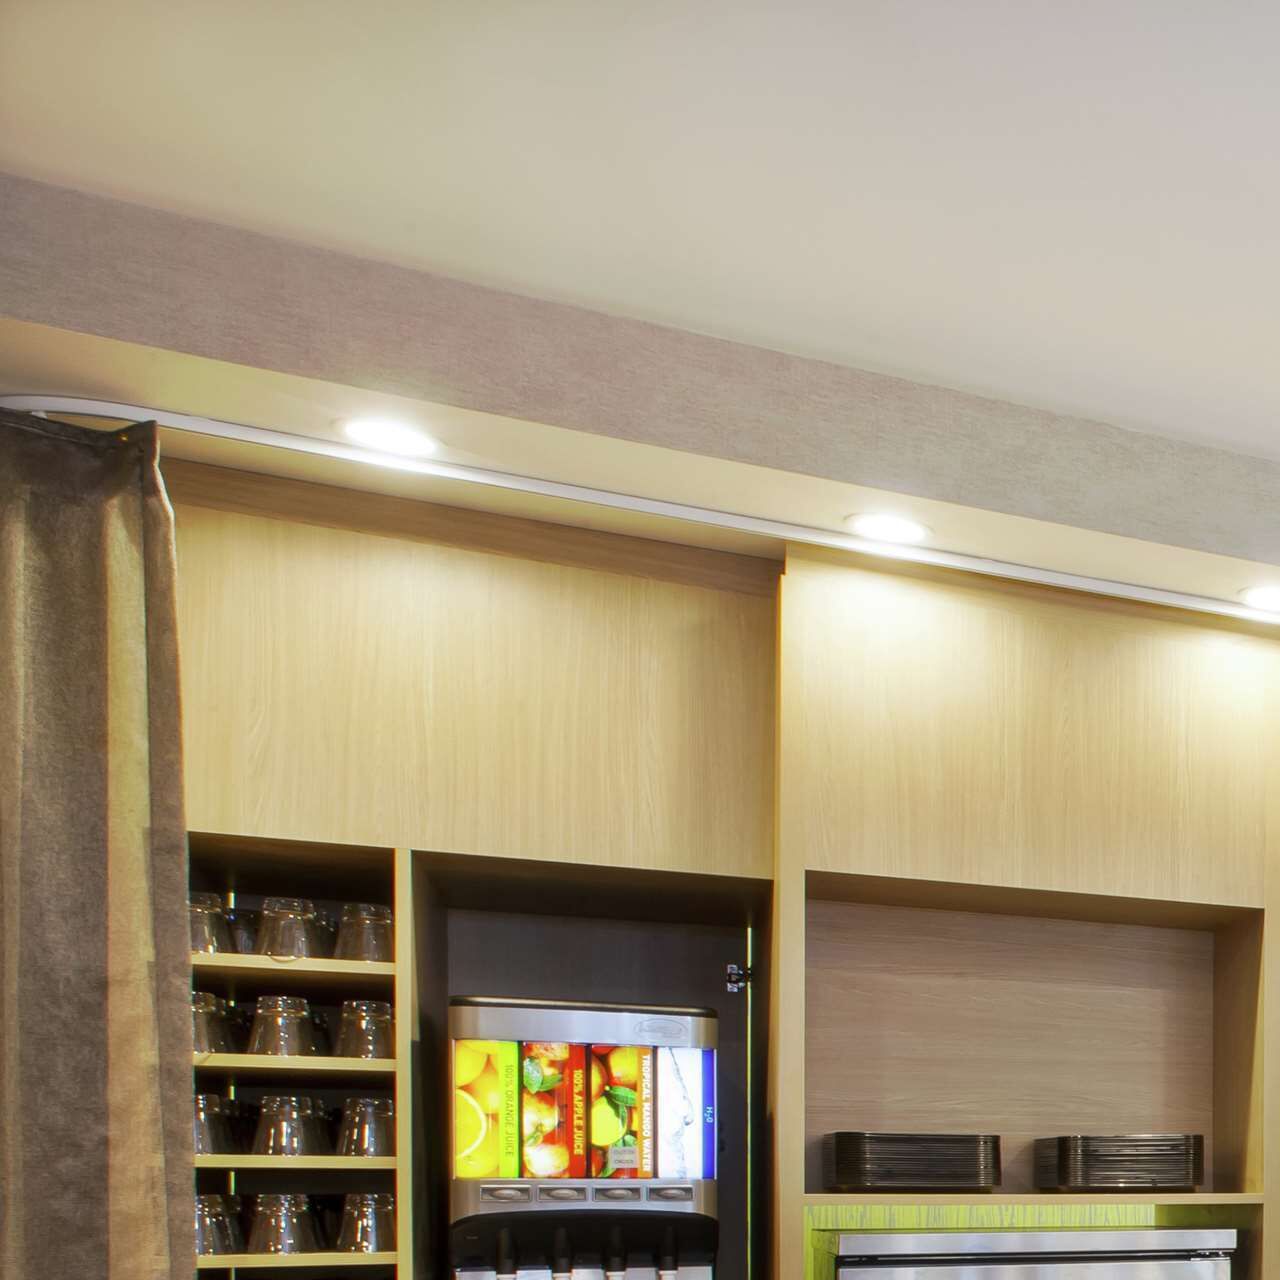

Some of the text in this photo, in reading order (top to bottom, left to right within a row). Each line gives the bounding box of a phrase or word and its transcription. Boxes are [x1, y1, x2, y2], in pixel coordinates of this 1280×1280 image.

[504, 1064, 515, 1157] 100% ORANGE JUICE
[573, 1069, 584, 1155] 100% APPLE JUICE
[641, 1054, 651, 1171] TROPICAL MANGO WATER
